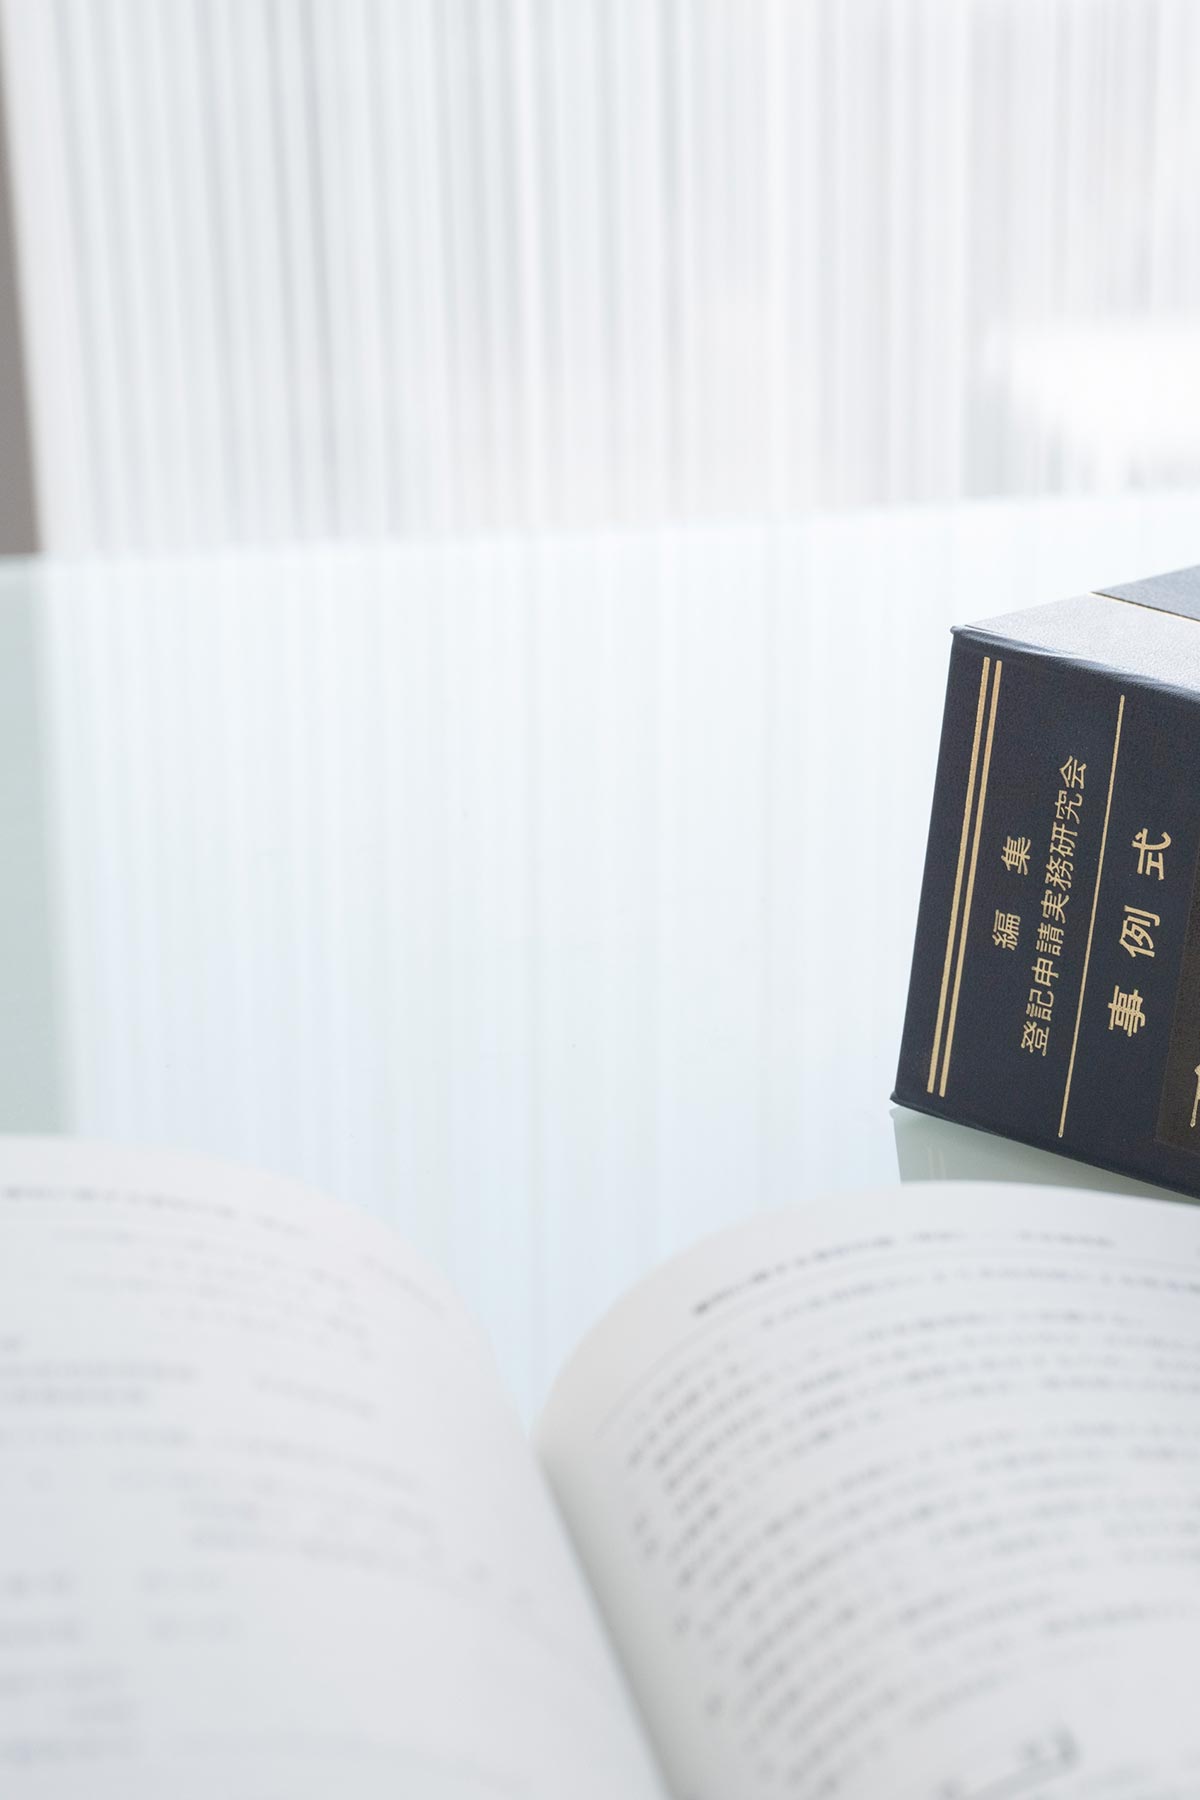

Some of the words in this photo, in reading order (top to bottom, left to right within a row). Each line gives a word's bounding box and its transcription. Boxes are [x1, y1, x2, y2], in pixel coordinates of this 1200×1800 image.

[1020, 756, 1088, 1056] 登記申請実務研究会
